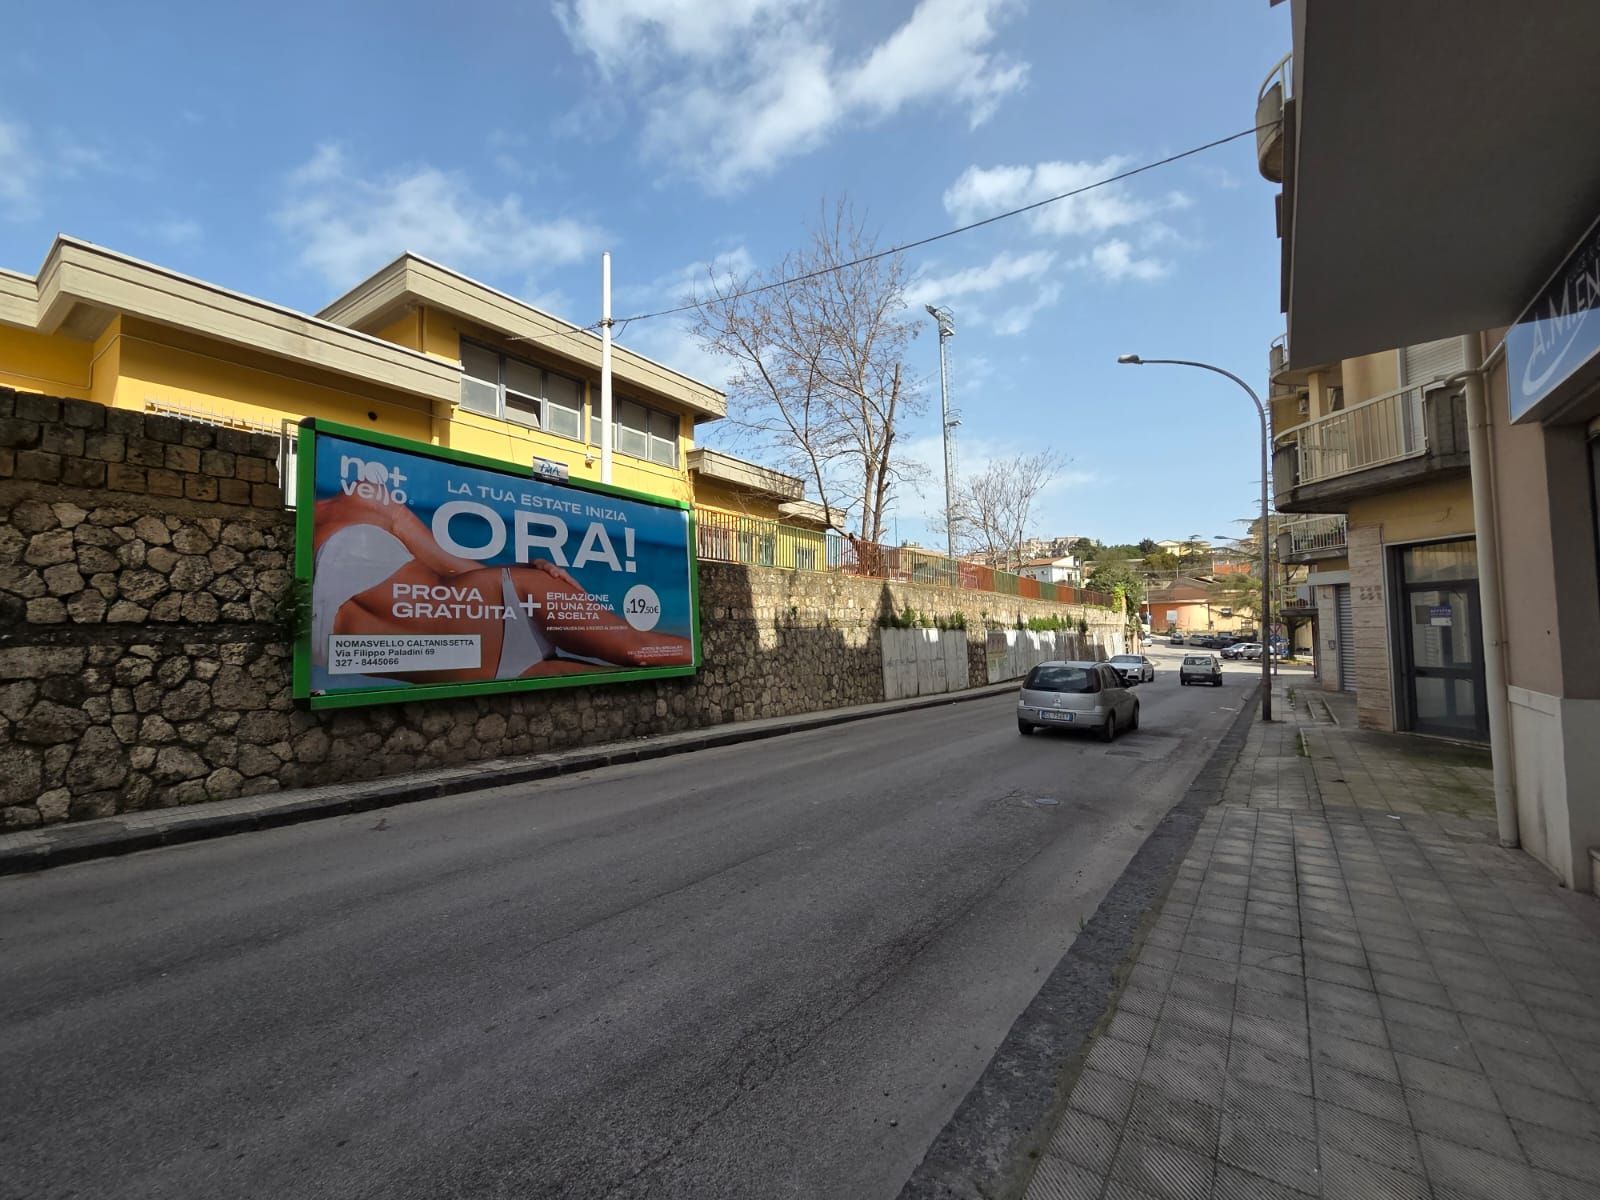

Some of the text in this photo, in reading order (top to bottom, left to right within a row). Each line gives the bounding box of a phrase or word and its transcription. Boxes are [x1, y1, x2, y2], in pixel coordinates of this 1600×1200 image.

[447, 479, 627, 523] LA TUA ESTATE INIZIA
[431, 500, 637, 573] ORA!
[392, 583, 484, 602] PROVA
[546, 592, 610, 602] EPILAZIONE
[391, 601, 517, 620] GRATUITA
[546, 602, 615, 611] DI UNA ZONA
[546, 611, 600, 620] A SCELTA
[335, 639, 475, 648] NOMASVELLO CALTANISSETTA
[335, 648, 436, 658] Via Filippo Paladini 69
[335, 659, 353, 667] 327
[361, 658, 400, 666] 8445066
